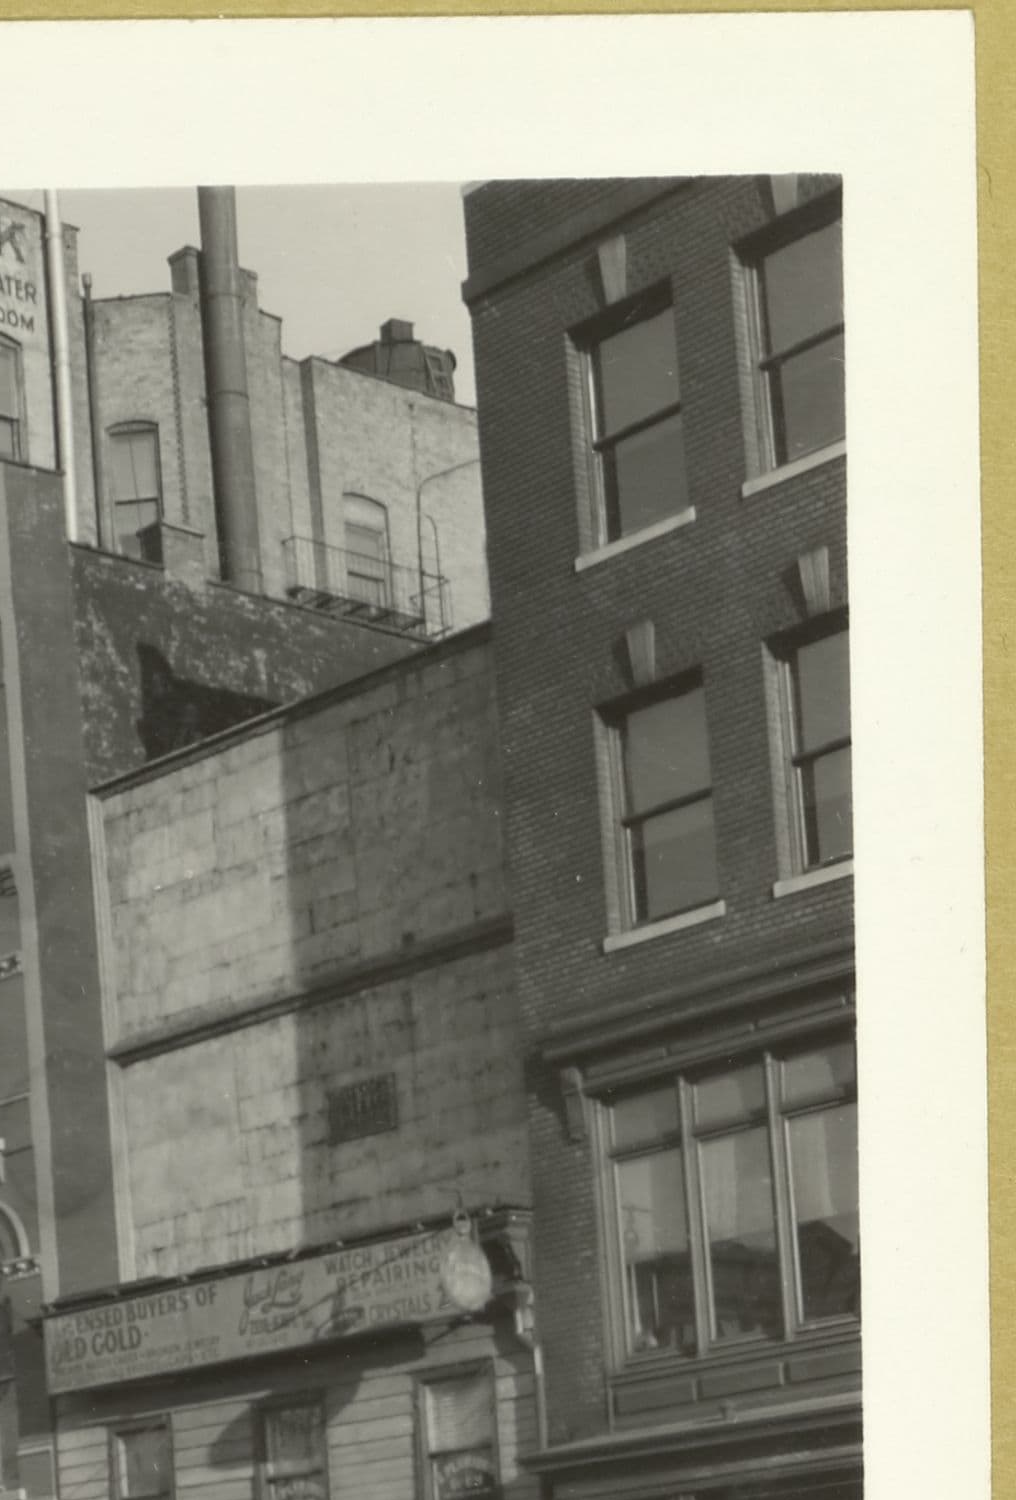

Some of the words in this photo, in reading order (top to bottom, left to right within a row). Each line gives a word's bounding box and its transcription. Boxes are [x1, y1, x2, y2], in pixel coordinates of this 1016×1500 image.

[324, 1252, 372, 1276] WATCH
[336, 1257, 442, 1293] REPAIRING
[125, 1291, 190, 1323] BUYERS
[194, 1283, 218, 1307] OF
[53, 1336, 88, 1368] OLD
[91, 1325, 143, 1357] GOLD
